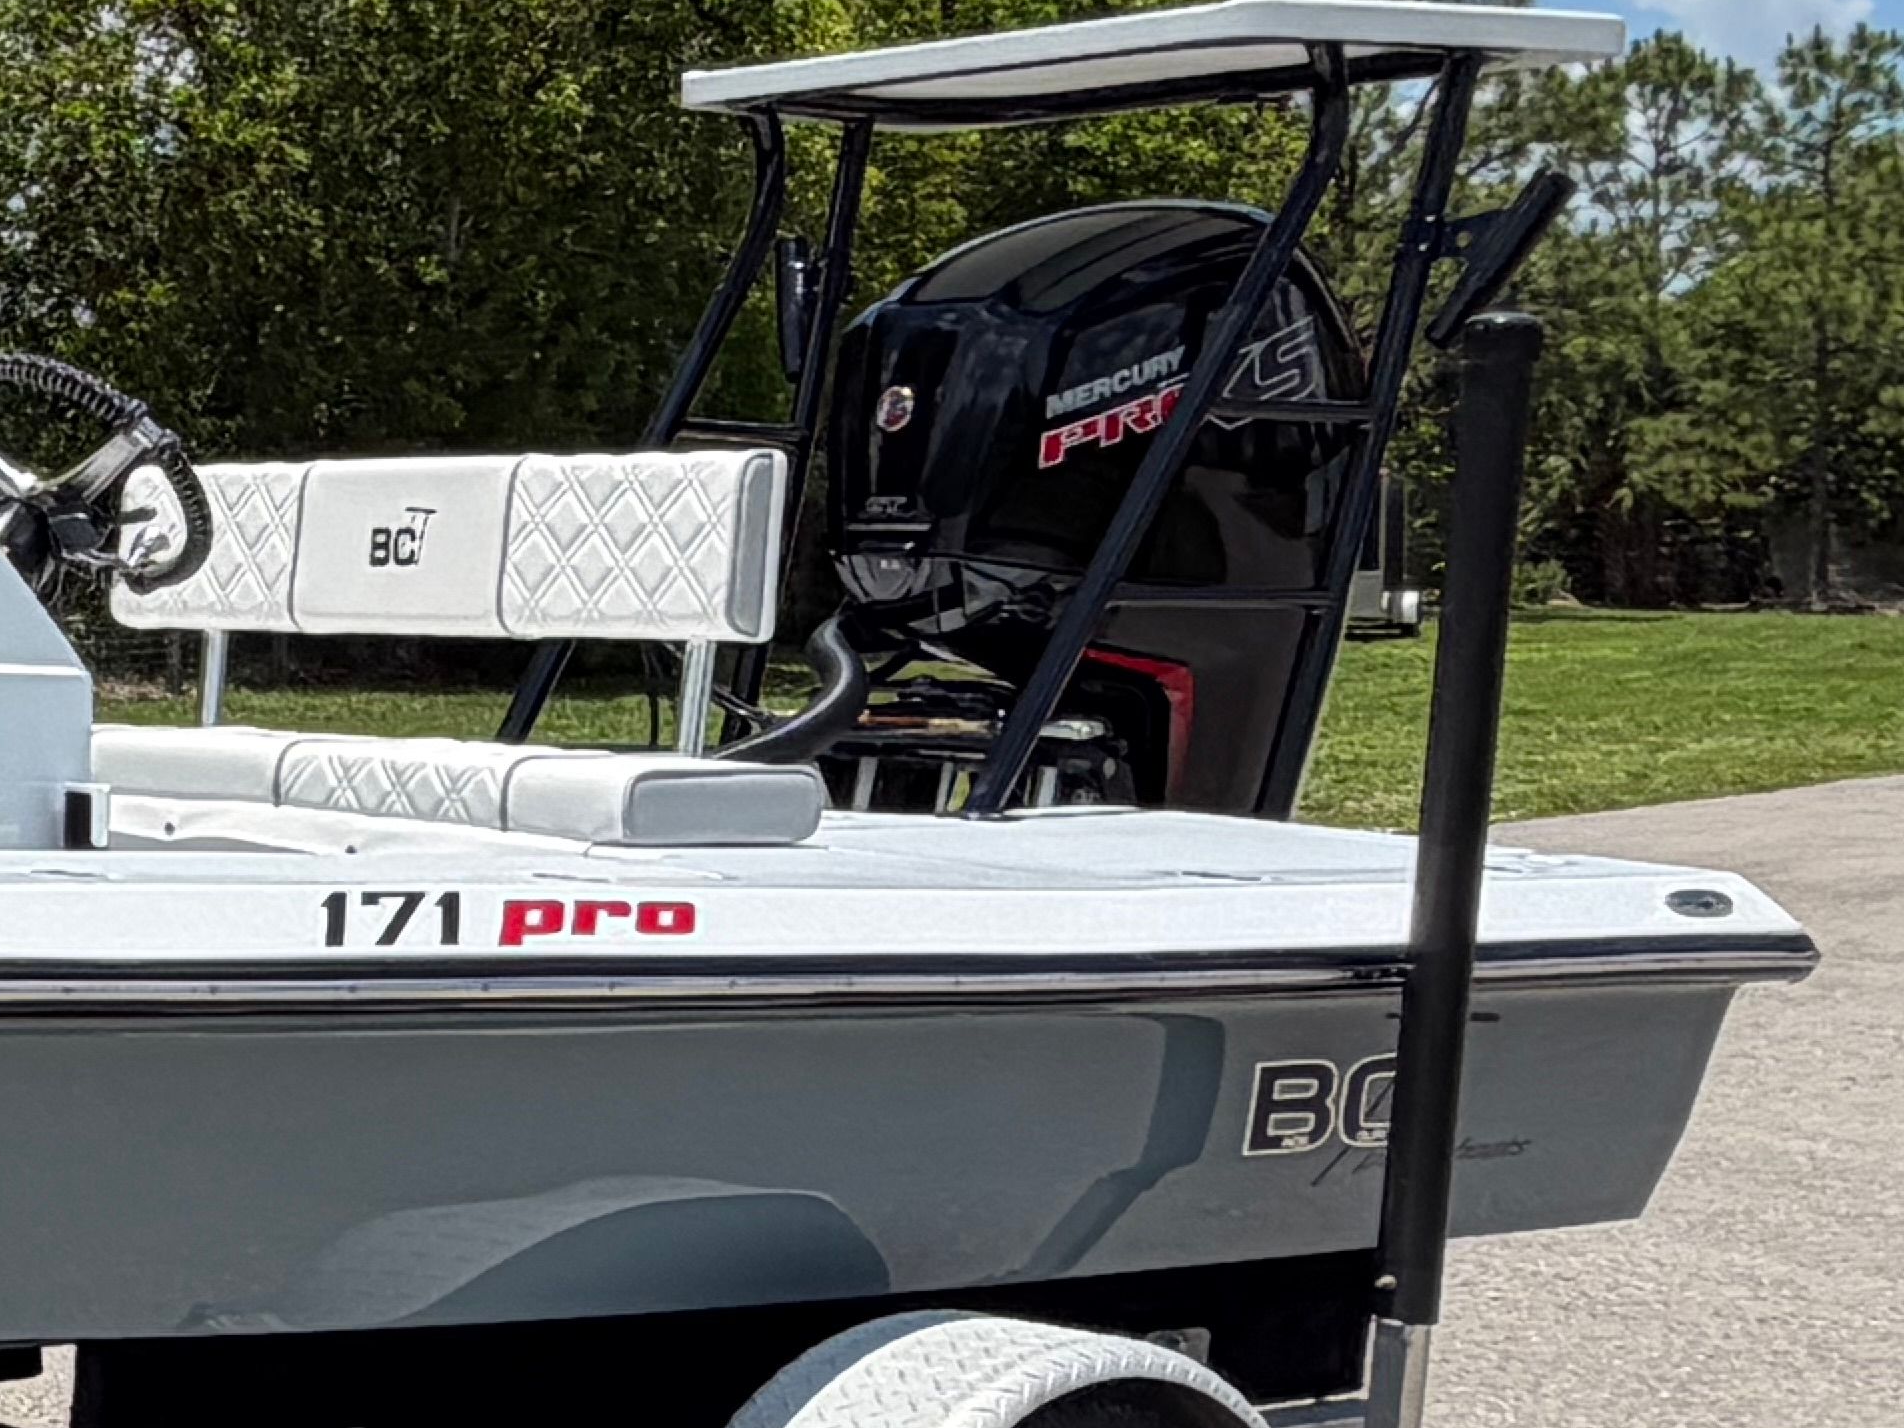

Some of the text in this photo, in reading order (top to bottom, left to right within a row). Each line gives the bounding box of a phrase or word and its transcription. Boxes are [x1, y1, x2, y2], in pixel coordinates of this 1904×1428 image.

[1046, 346, 1186, 419] MERCURY
[321, 891, 695, 947] 171 pro
